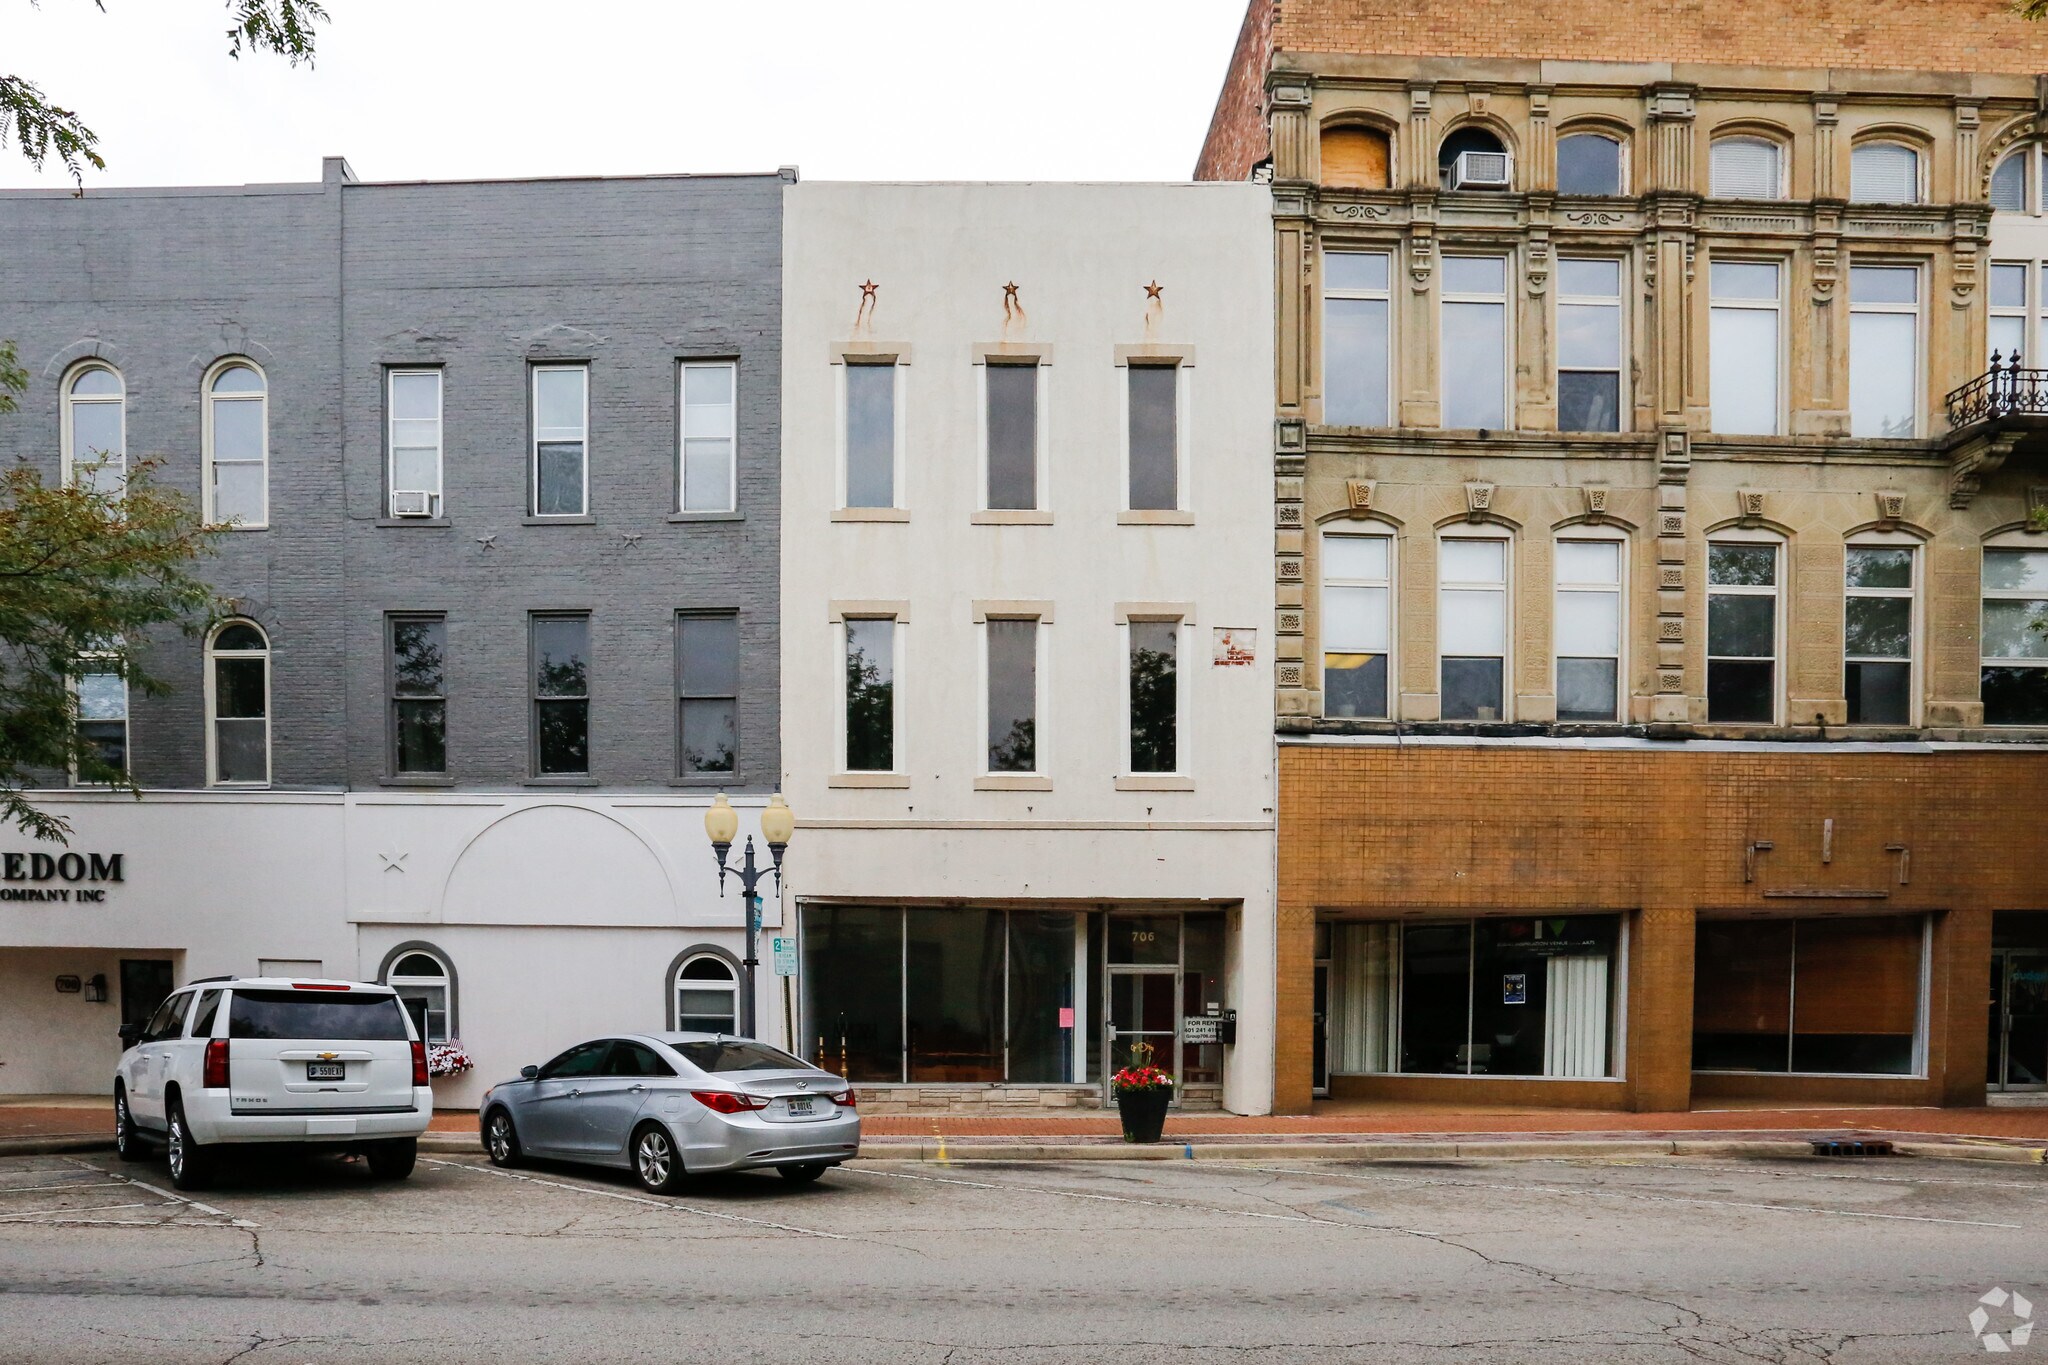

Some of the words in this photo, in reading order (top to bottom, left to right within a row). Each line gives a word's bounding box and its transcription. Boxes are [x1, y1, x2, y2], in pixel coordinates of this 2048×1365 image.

[0, 888, 70, 902] OMPANY
[76, 890, 105, 902] INC
[1131, 931, 1155, 942] 706
[774, 940, 781, 950] 2
